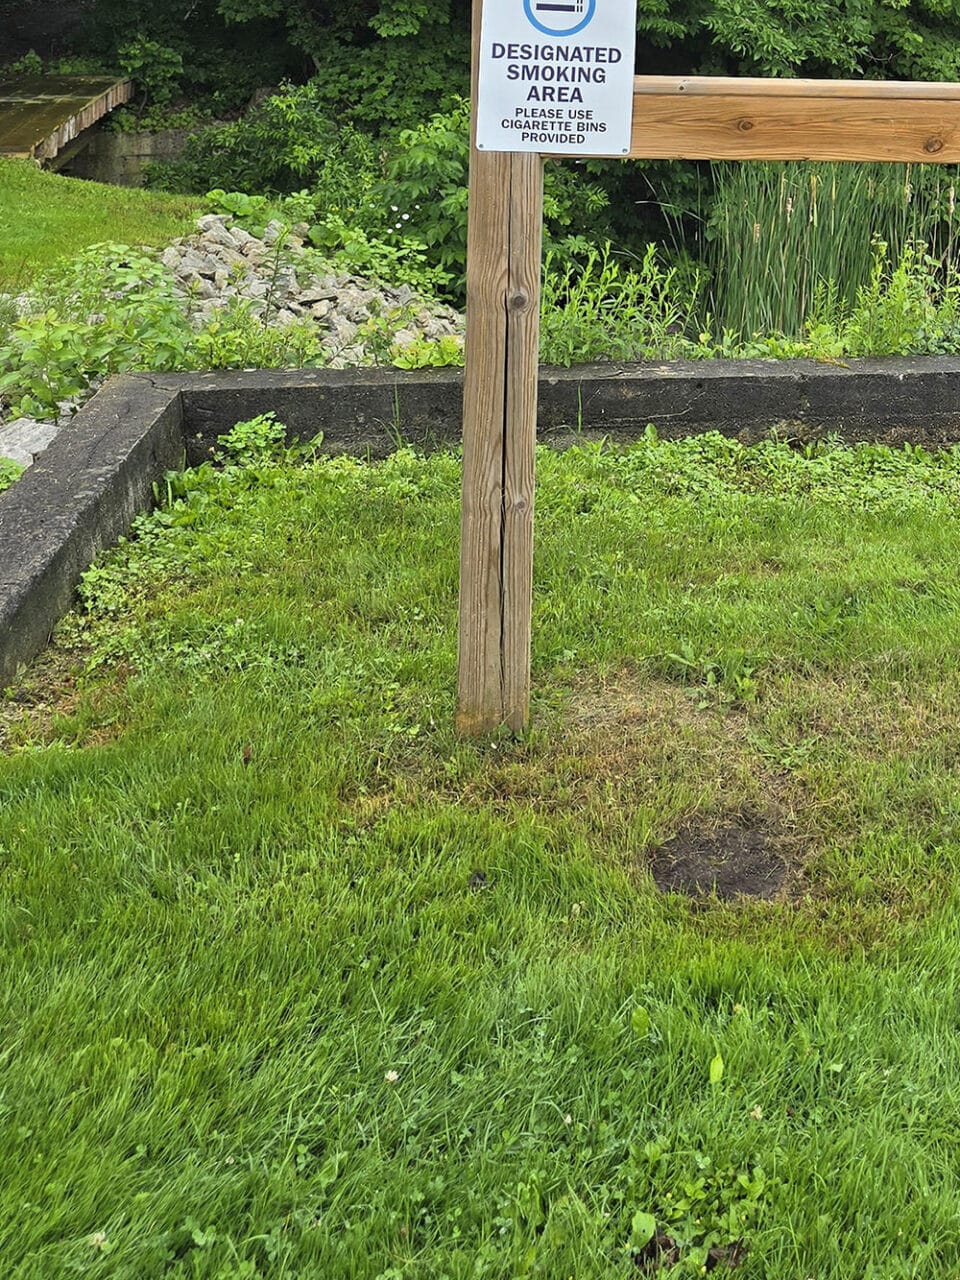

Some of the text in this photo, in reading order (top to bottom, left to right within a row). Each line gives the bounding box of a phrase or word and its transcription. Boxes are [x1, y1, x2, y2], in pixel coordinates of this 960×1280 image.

[491, 43, 622, 64] DESIGNATED
[506, 64, 606, 84] SMOKING
[526, 85, 584, 103] AREA
[515, 107, 594, 120] PLEASE USE
[501, 119, 607, 133] CIGARETTE BINS
[521, 132, 586, 144] PROVIDED
